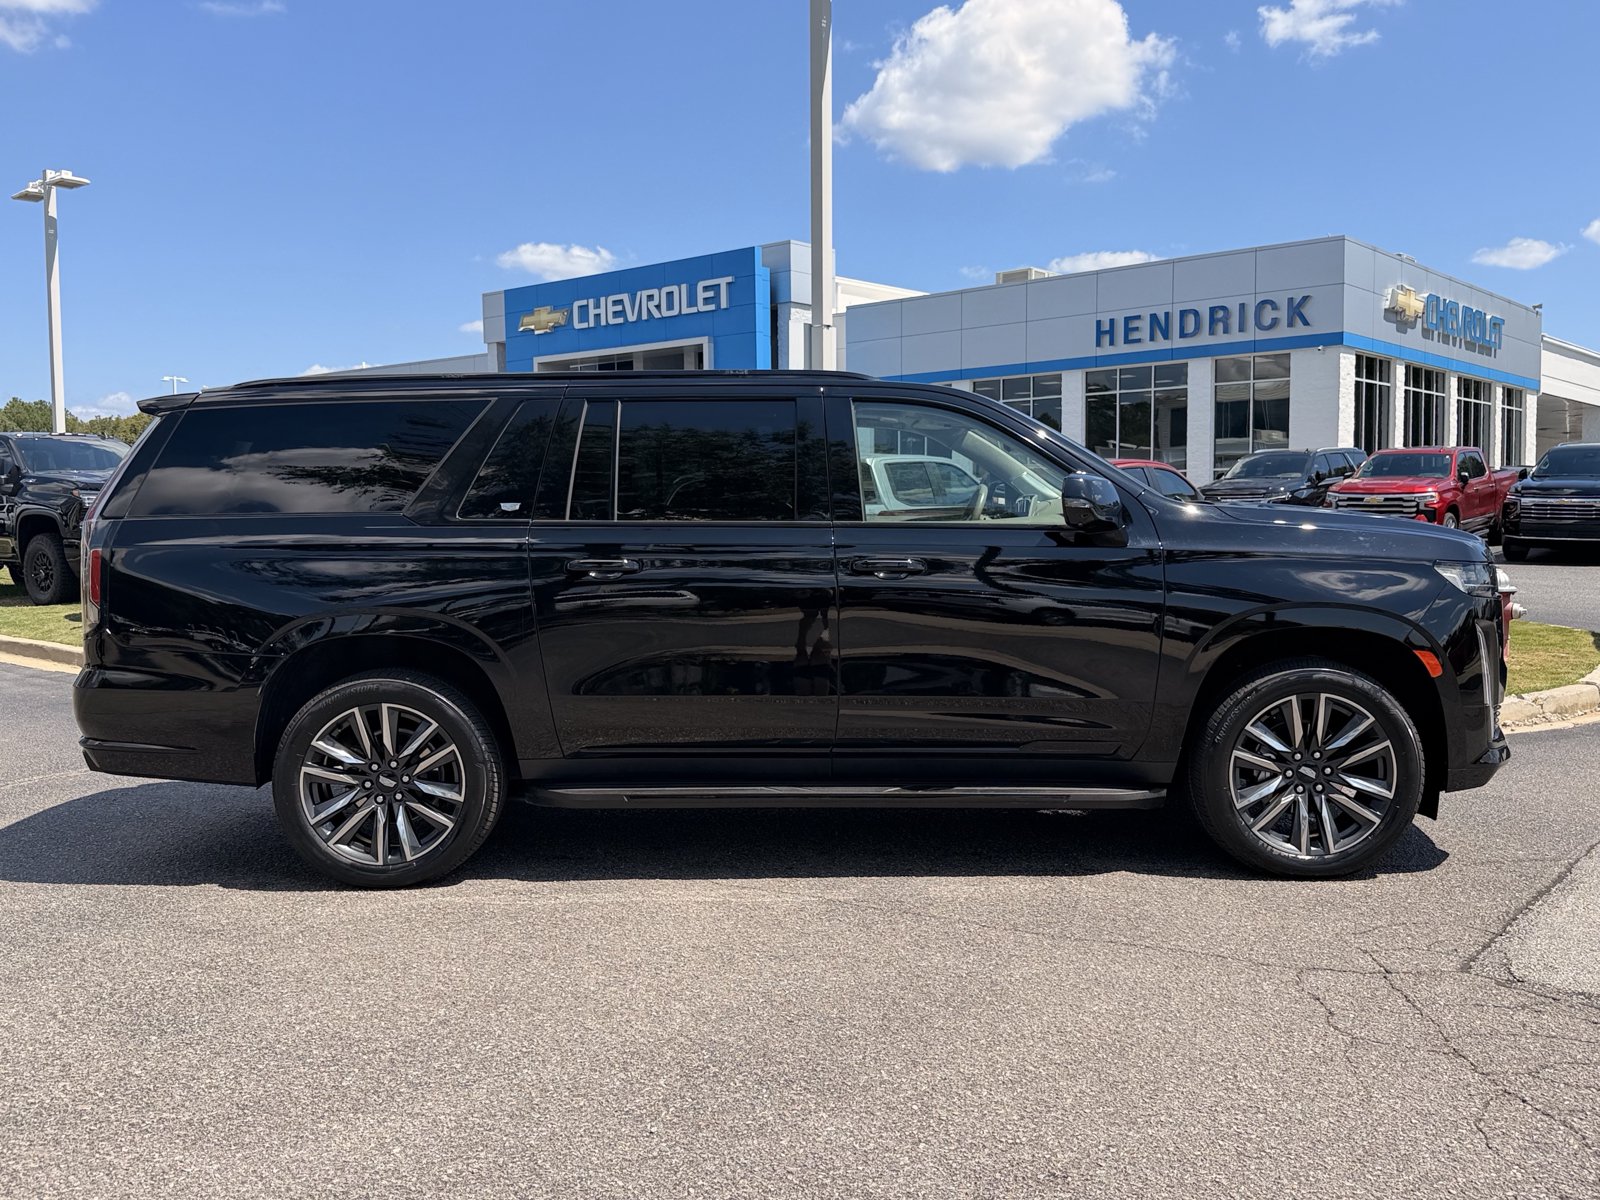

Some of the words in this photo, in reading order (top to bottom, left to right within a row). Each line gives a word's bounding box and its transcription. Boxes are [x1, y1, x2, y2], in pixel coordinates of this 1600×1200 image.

[572, 276, 735, 330] CHEVROLET
[1096, 295, 1312, 347] HENDRICK
[1425, 293, 1506, 350] CHEVROLET
